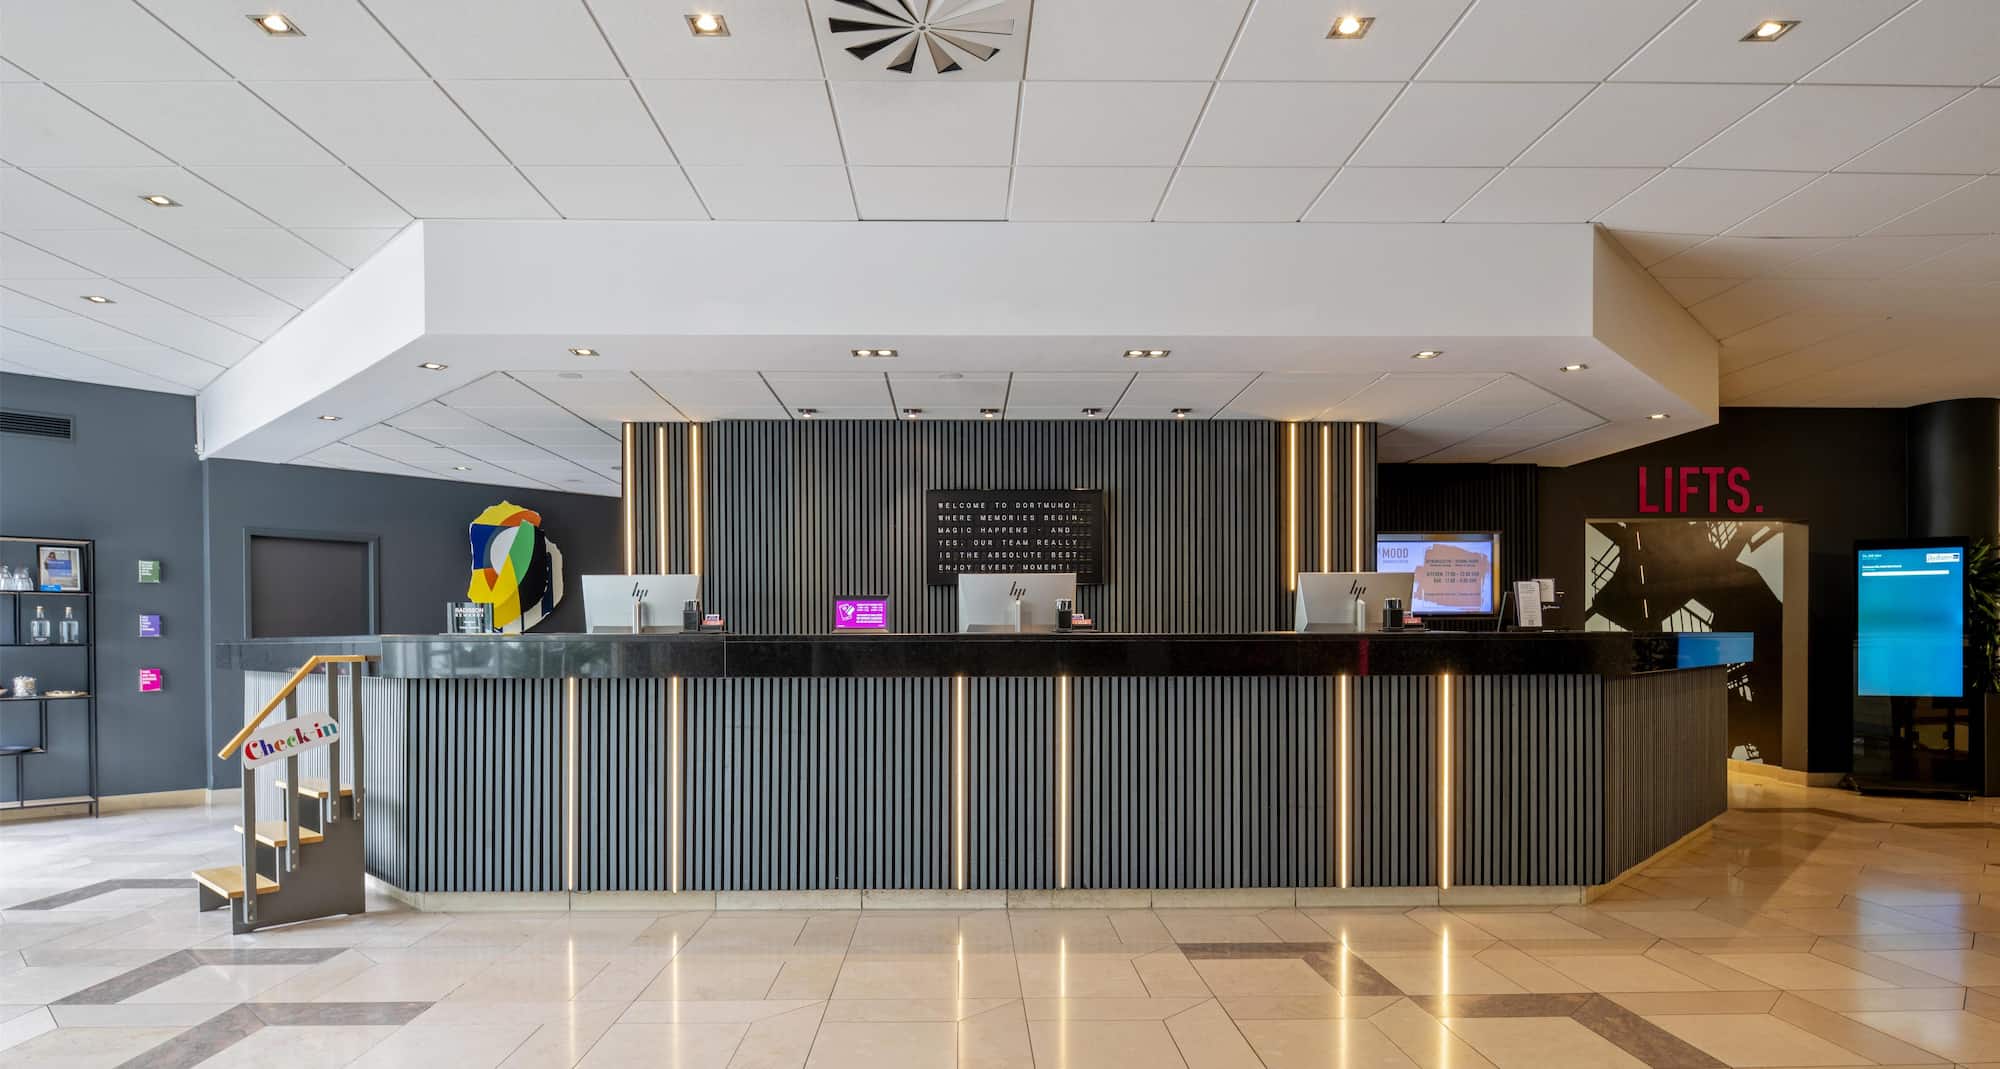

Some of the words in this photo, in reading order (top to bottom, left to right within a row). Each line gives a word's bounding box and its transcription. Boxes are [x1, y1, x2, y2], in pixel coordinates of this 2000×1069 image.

[1639, 466, 1764, 514] LIFTS.
[939, 551, 951, 559] IS
[959, 551, 978, 559] THE
[987, 551, 1042, 559] ABSOLUTE
[1382, 547, 1409, 559] MOOD
[632, 581, 648, 601] hp
[1009, 581, 1026, 601] hp
[1350, 579, 1367, 601] hp
[245, 722, 338, 760] Check-in
